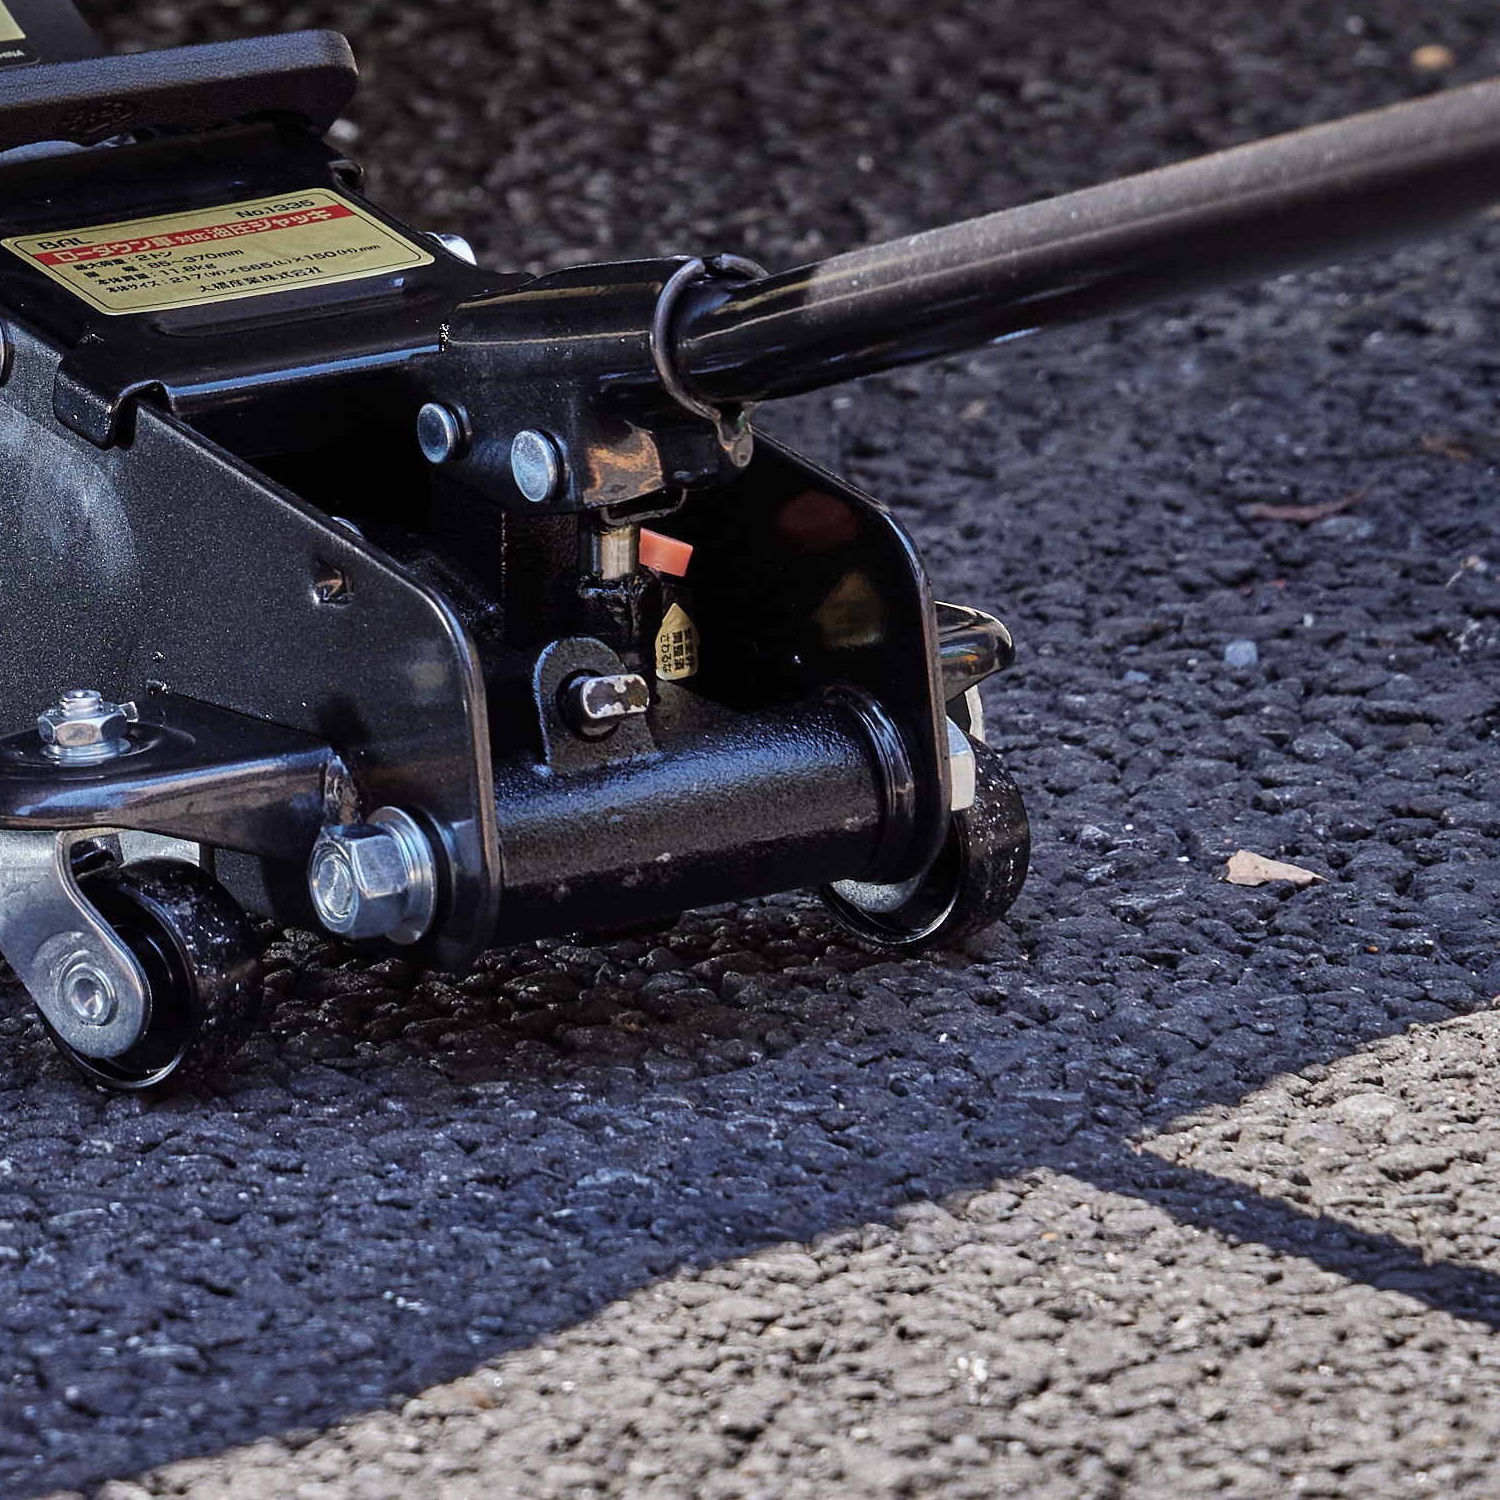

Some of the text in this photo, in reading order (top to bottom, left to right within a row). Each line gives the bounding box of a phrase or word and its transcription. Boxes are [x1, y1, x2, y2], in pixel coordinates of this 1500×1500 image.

[235, 200, 315, 219] No.1335
[37, 237, 93, 250] BAL
[197, 266, 324, 293] 大橋産業株式会社
[660, 633, 672, 673] さわるな
